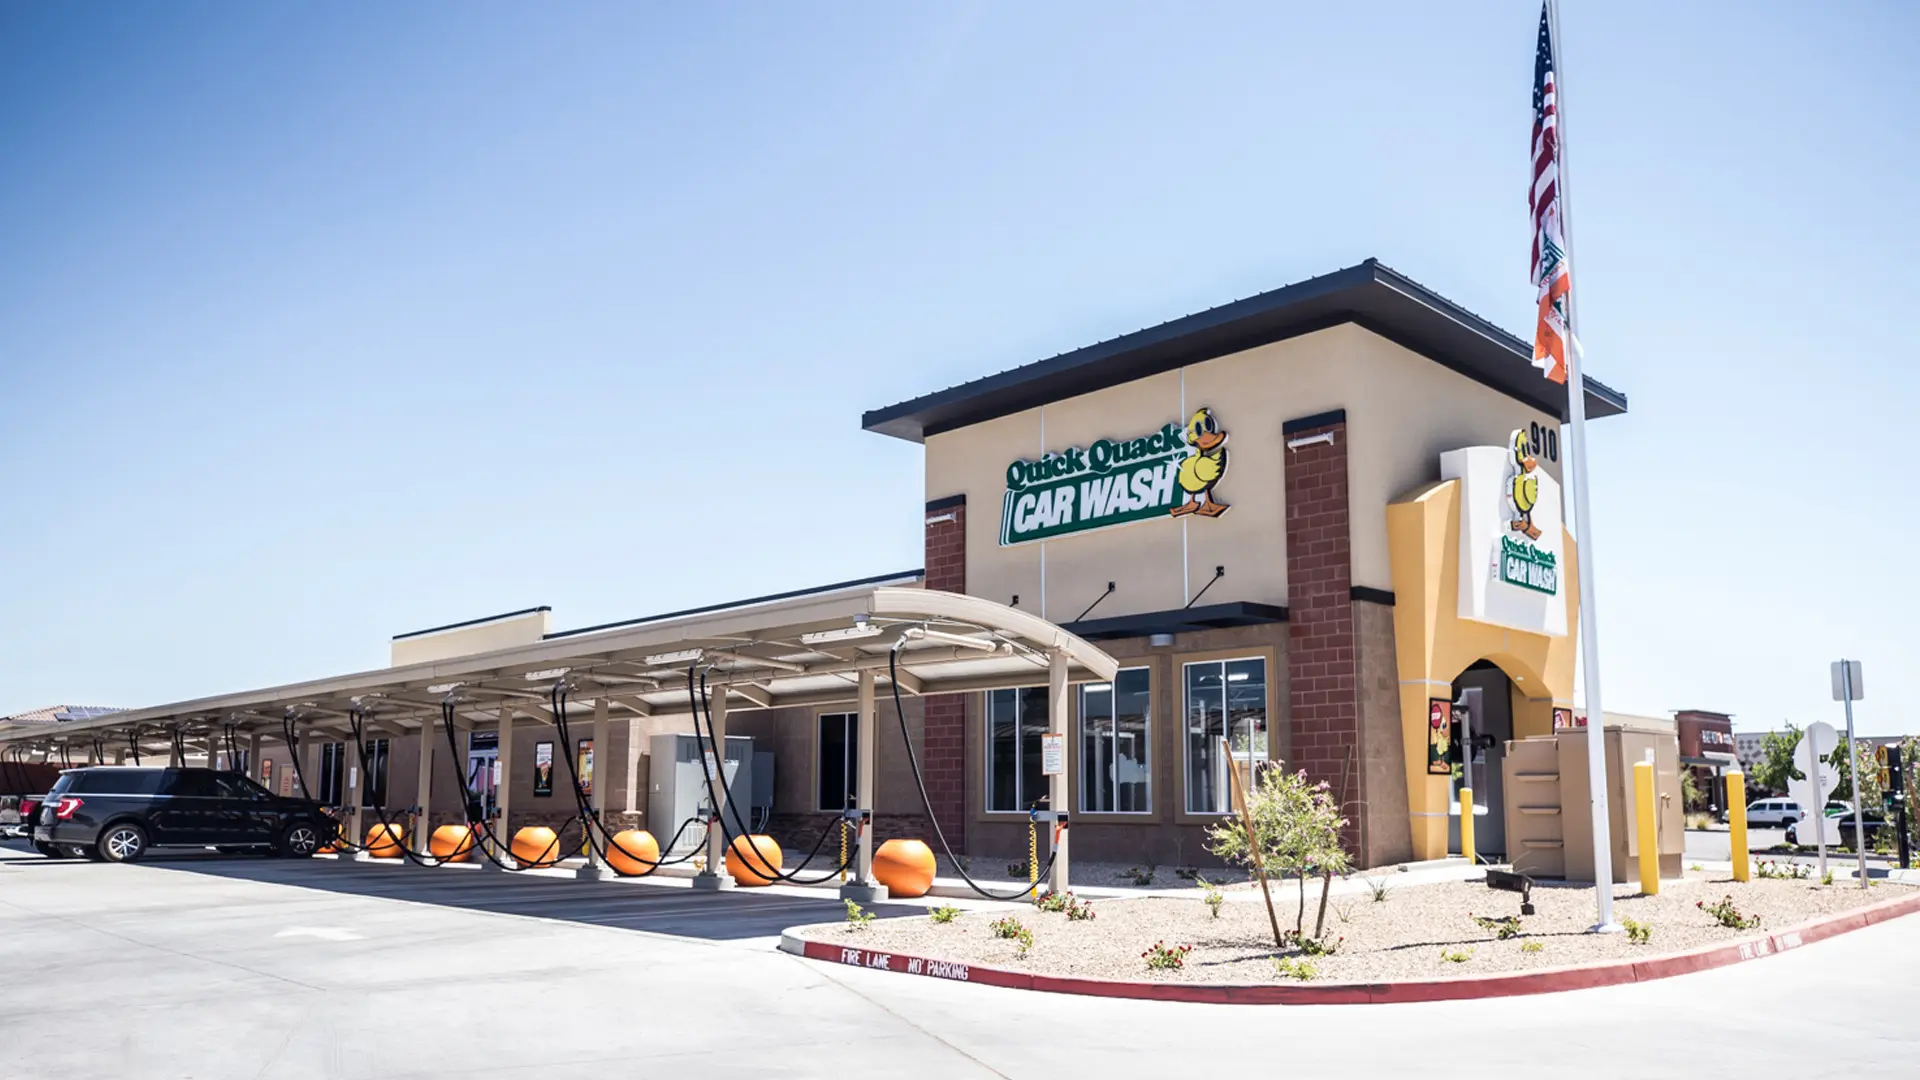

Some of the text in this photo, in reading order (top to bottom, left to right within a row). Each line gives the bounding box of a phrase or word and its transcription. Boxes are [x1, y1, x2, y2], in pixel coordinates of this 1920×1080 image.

[1006, 423, 1187, 492] Quick Quack
[1530, 421, 1557, 463] 910
[1014, 464, 1174, 534] CAR WASH
[1506, 556, 1527, 584] CAR
[1528, 560, 1556, 592] WASH
[841, 948, 861, 966] FIRE
[866, 952, 892, 971] LANE
[926, 959, 969, 981] PARKING
